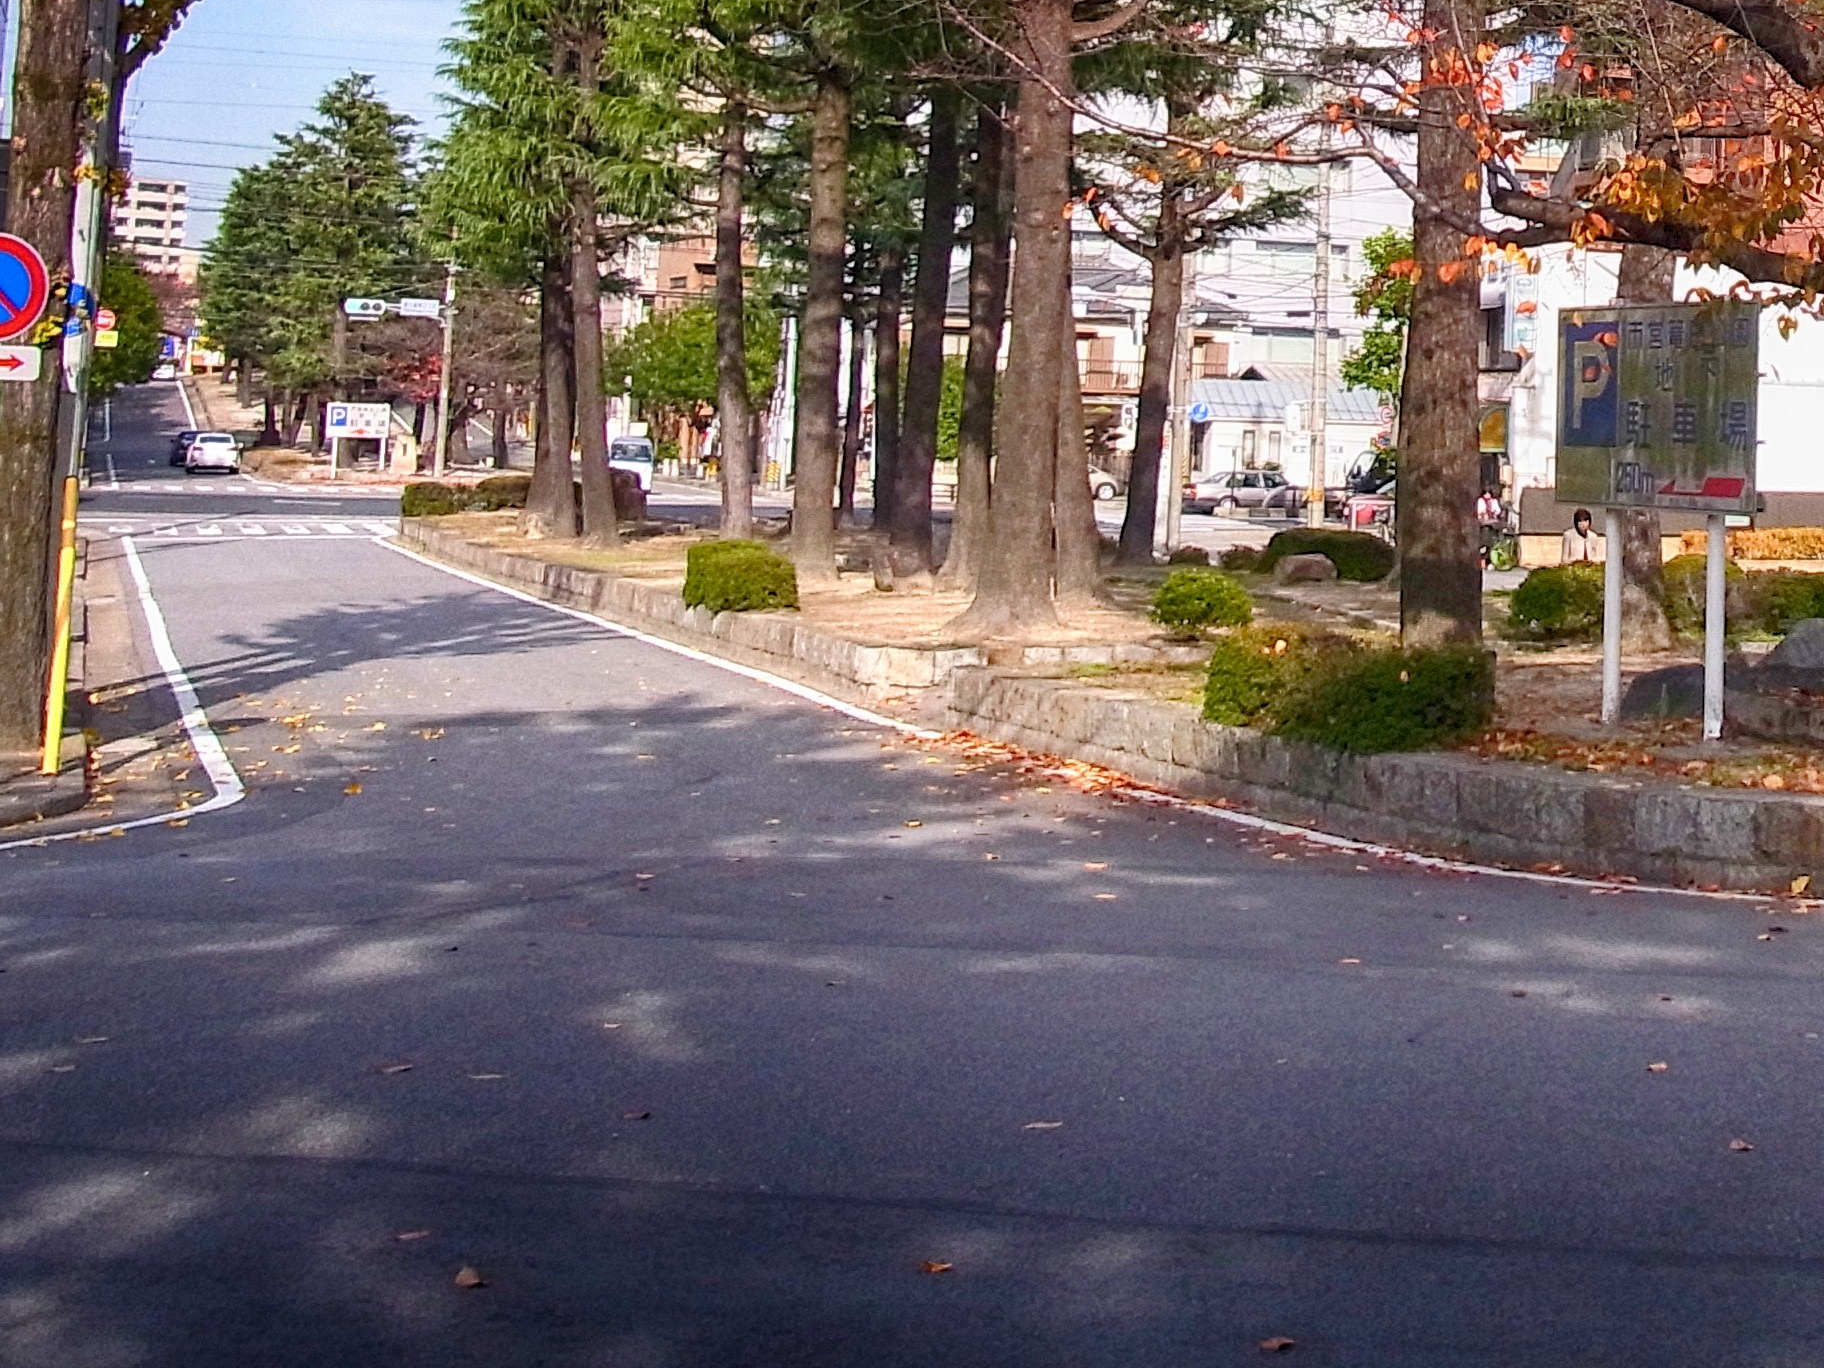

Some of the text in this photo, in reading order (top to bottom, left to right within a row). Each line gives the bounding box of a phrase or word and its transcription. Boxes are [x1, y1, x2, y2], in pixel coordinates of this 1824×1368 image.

[1574, 341, 1610, 429] P
[332, 408, 346, 424] P
[1626, 400, 1748, 451] 駐車場
[1616, 462, 1655, 494] 250m
